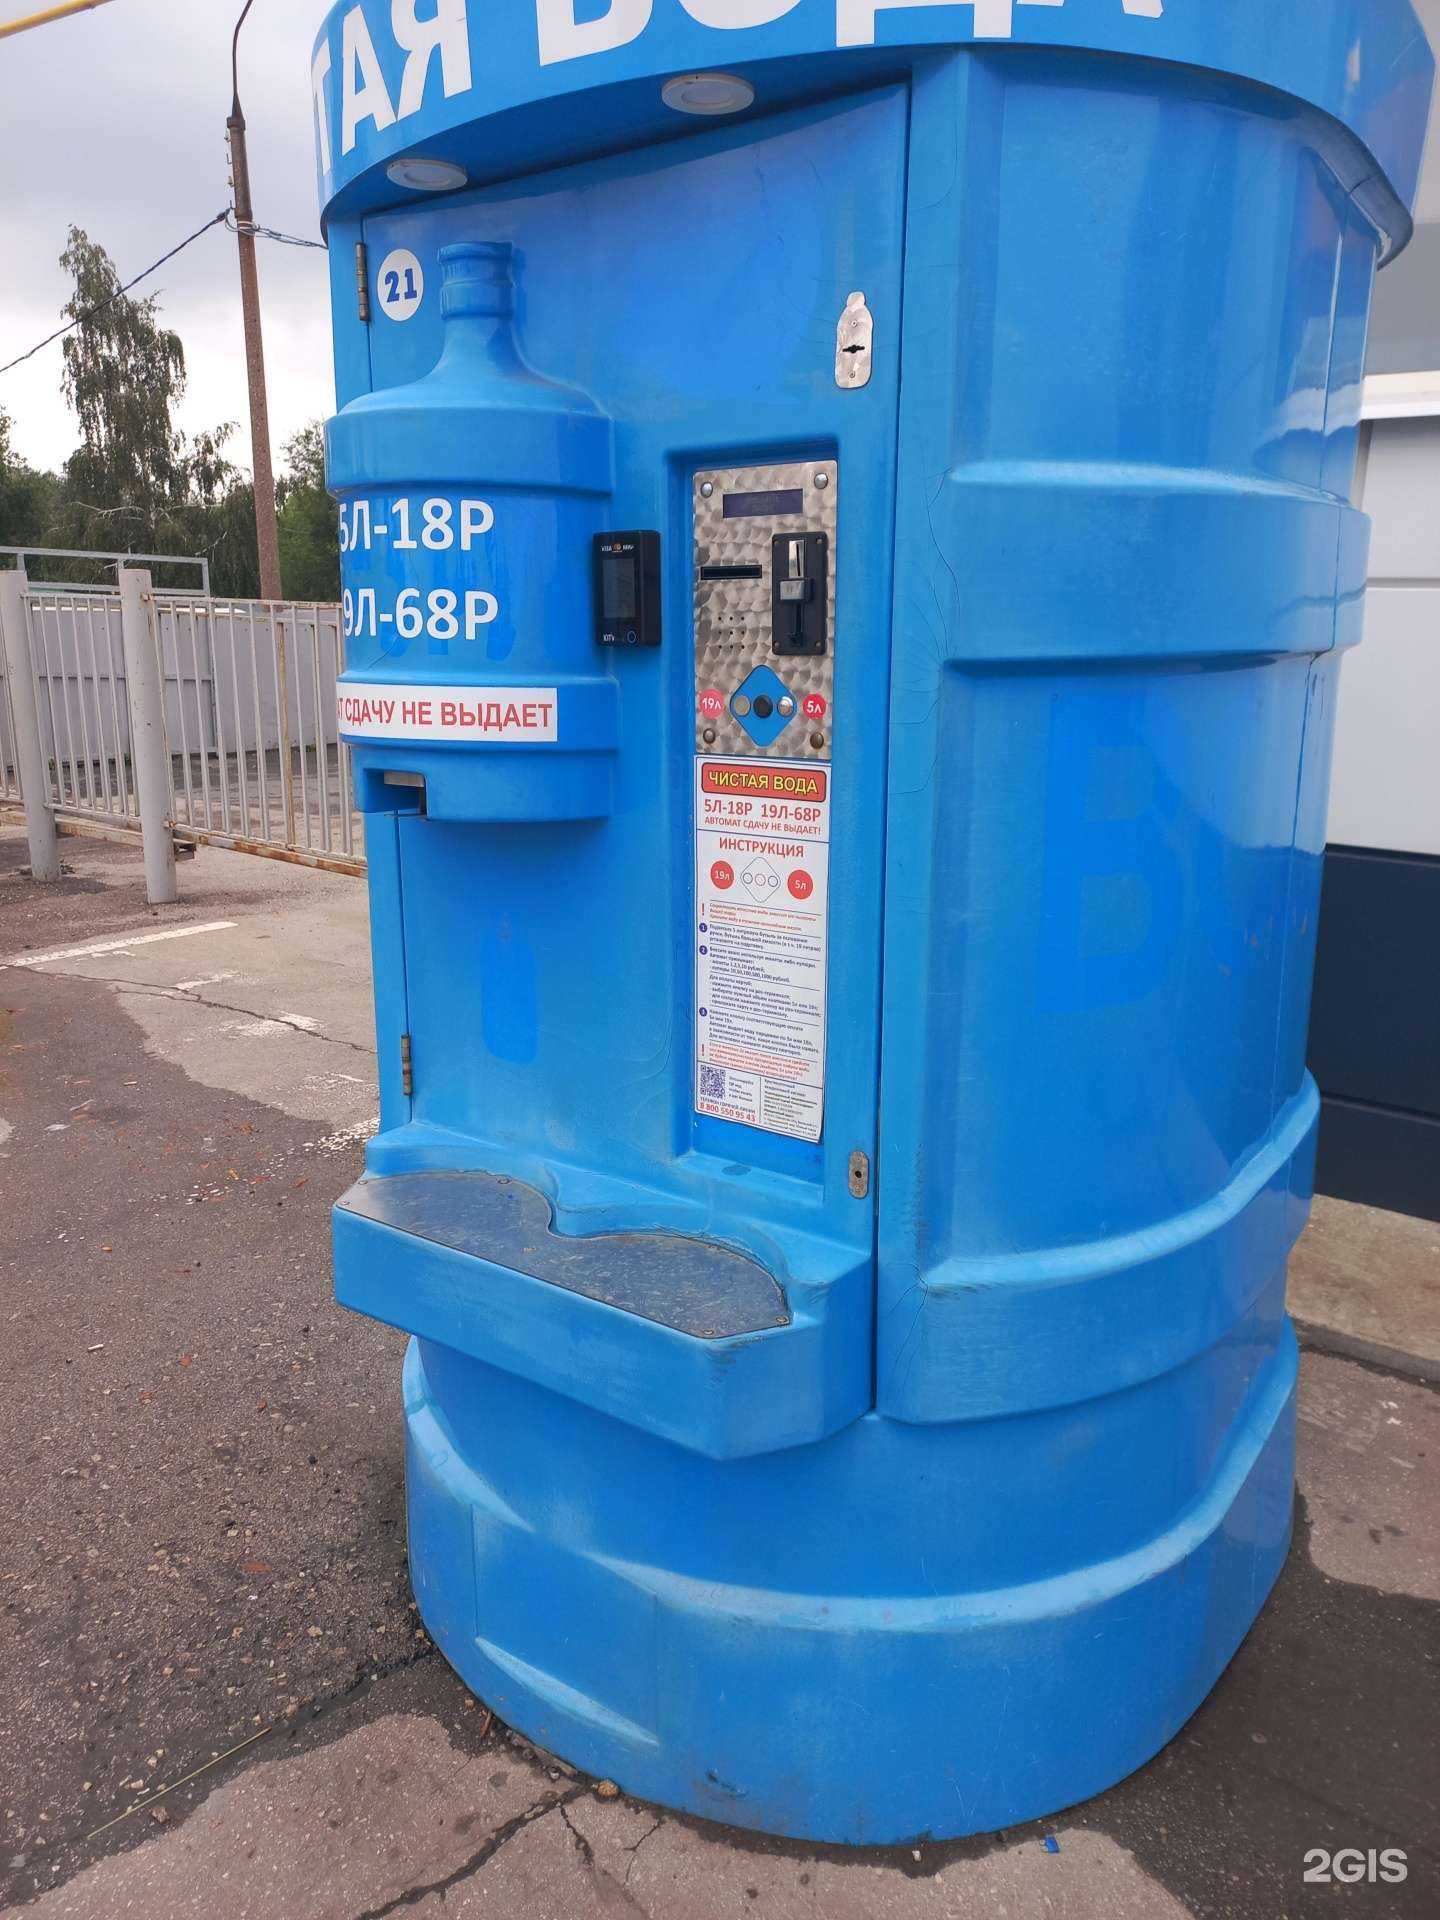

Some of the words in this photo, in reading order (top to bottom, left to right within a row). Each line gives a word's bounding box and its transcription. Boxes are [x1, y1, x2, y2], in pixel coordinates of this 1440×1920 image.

[384, 268, 418, 303] 21
[345, 698, 395, 726] СДАЧУ
[402, 701, 432, 725] НЕ
[441, 702, 552, 731] ВЫДАЕТ
[708, 771, 768, 789] ЧИСТАЯ
[773, 776, 818, 794] ВОДА
[704, 799, 752, 815] 5Л-18Р
[761, 804, 821, 822] 19Л-68Р
[704, 817, 741, 828] АВТОМАТ
[743, 821, 769, 831] СДАЧУ
[771, 823, 782, 831] НЕ
[784, 824, 821, 836] ВЫДАЕТ!
[719, 837, 804, 858] ИНСТРУКЦИЯ
[715, 869, 730, 880] 19л
[795, 879, 806, 890] 5л
[706, 1103, 718, 1112] 800
[720, 1107, 734, 1116] 550
[735, 1111, 744, 1119] 95
[746, 1114, 755, 1122] 43
